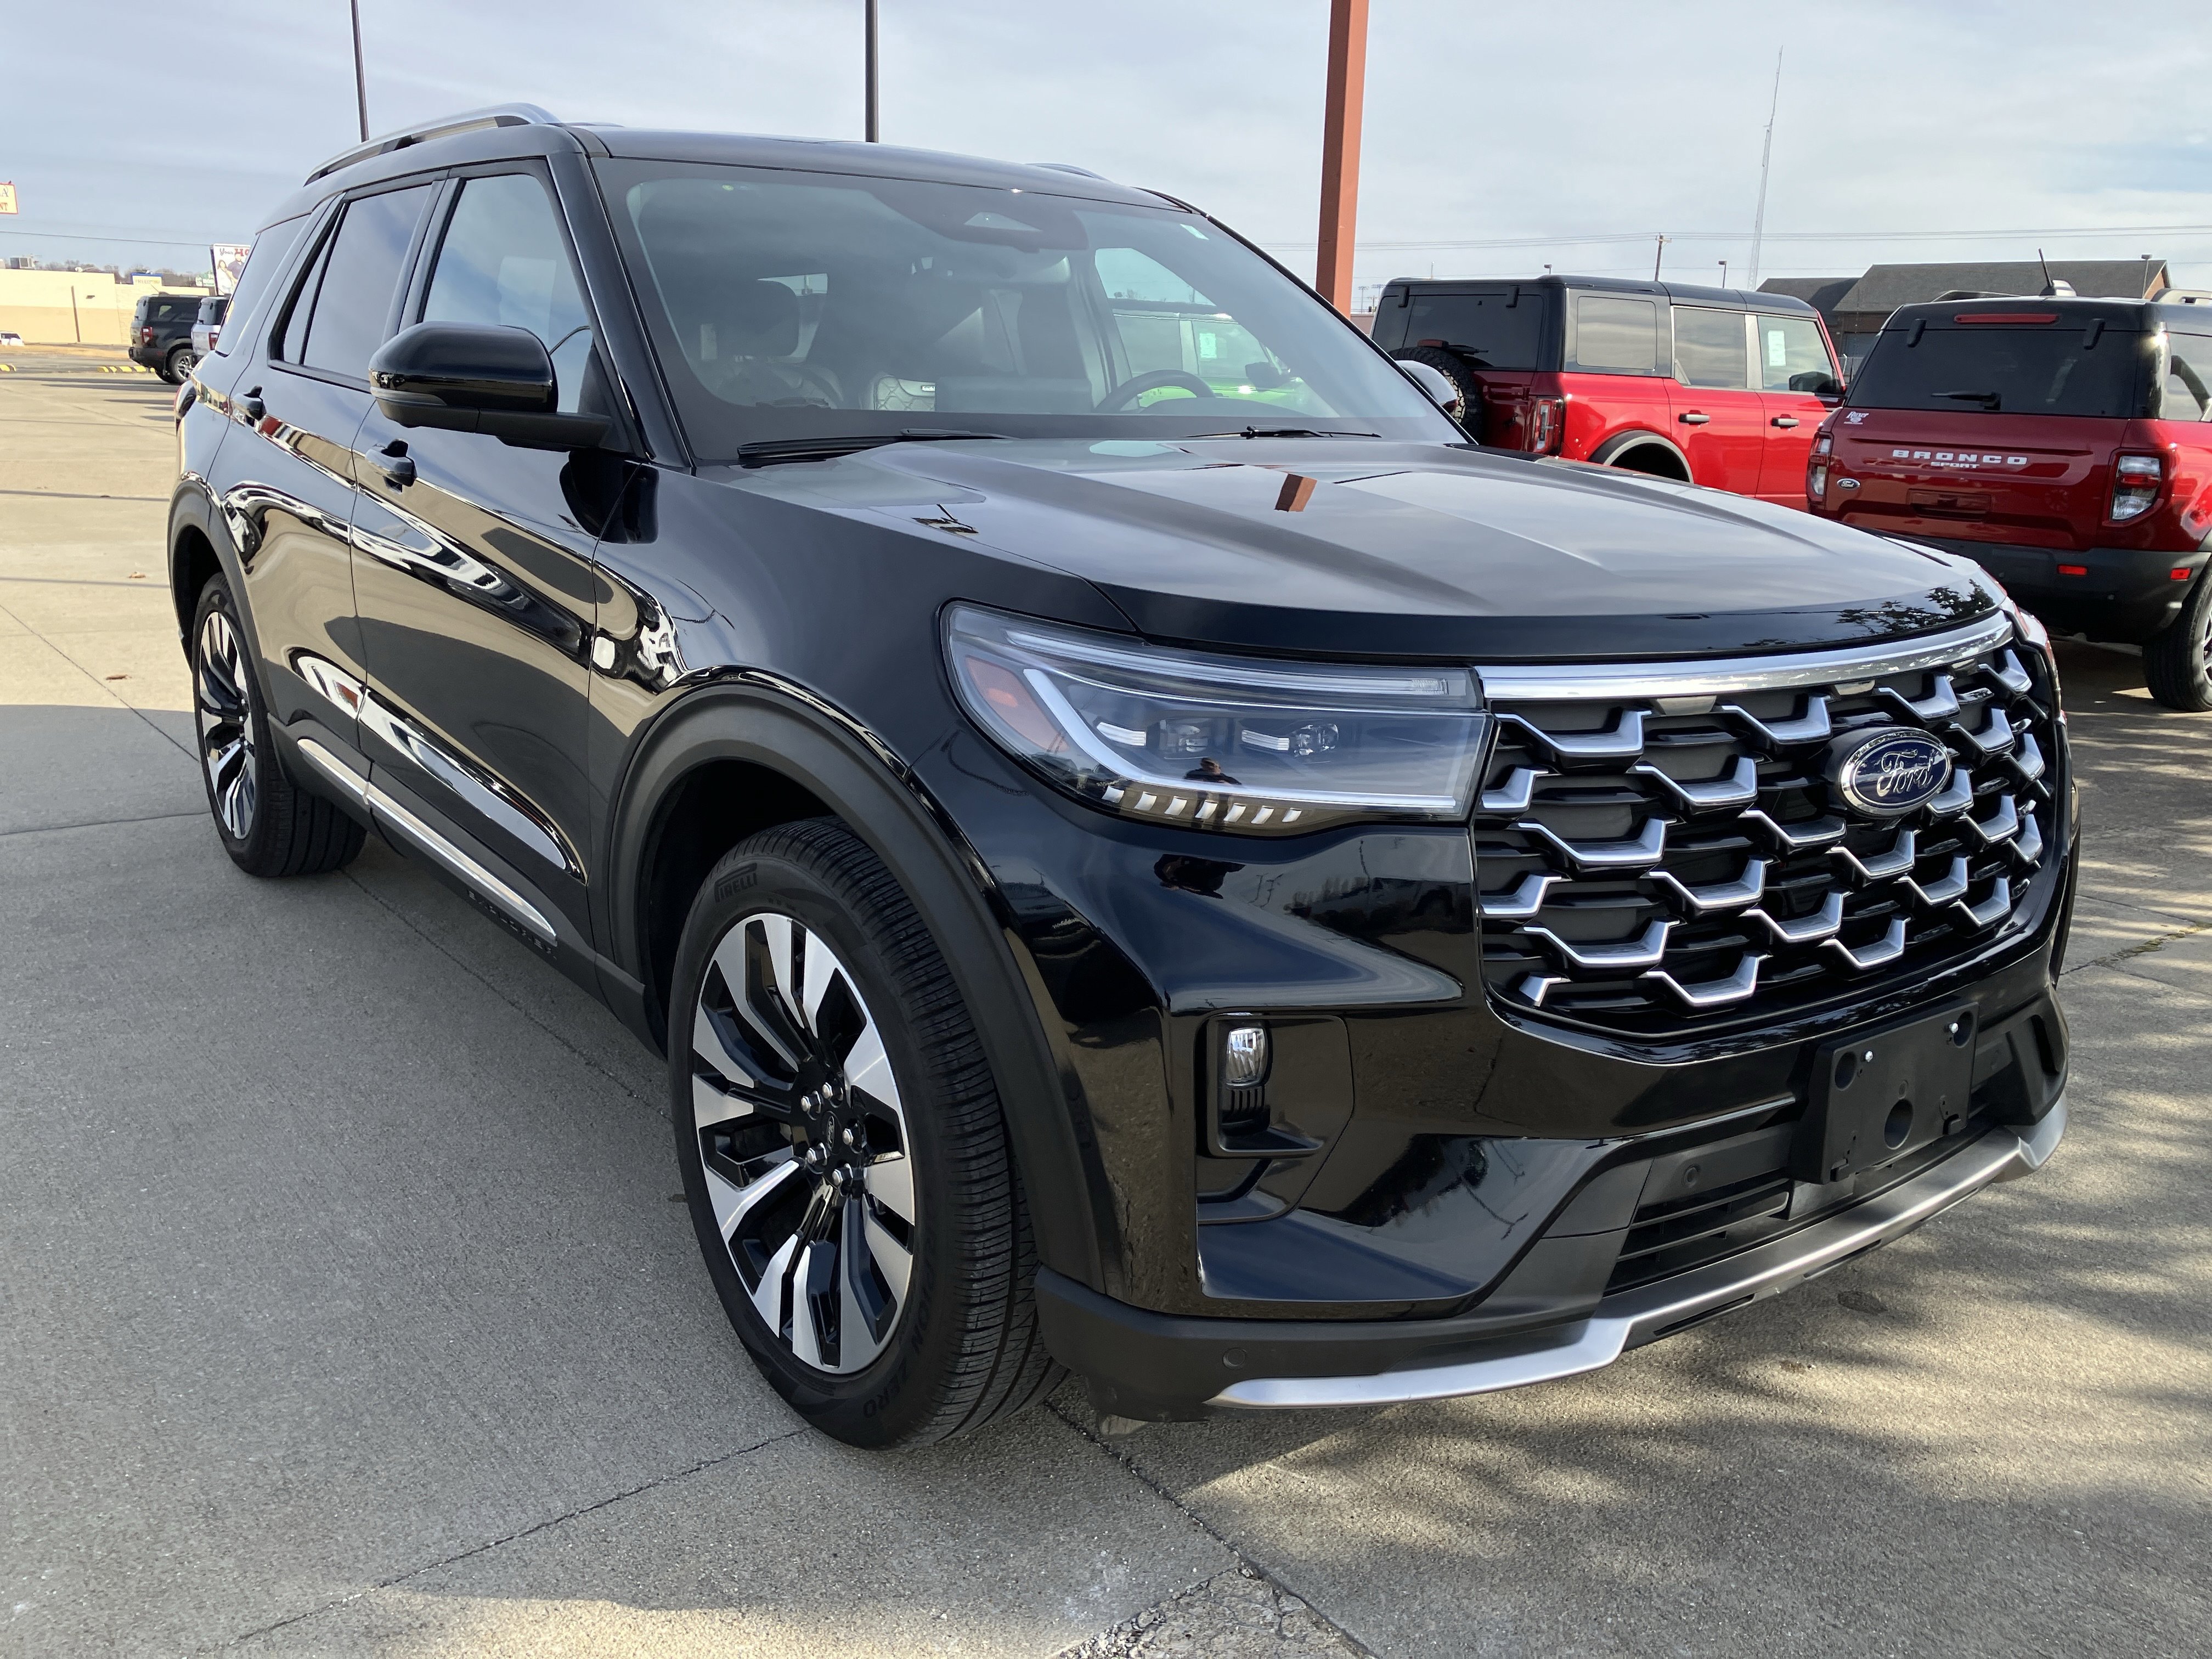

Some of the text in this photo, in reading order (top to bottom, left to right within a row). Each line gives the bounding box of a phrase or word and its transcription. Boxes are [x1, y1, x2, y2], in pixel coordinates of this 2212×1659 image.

[1892, 449, 2028, 465] BRONCO
[1876, 749, 1933, 797] Ford
[714, 862, 758, 903] PIRELLI
